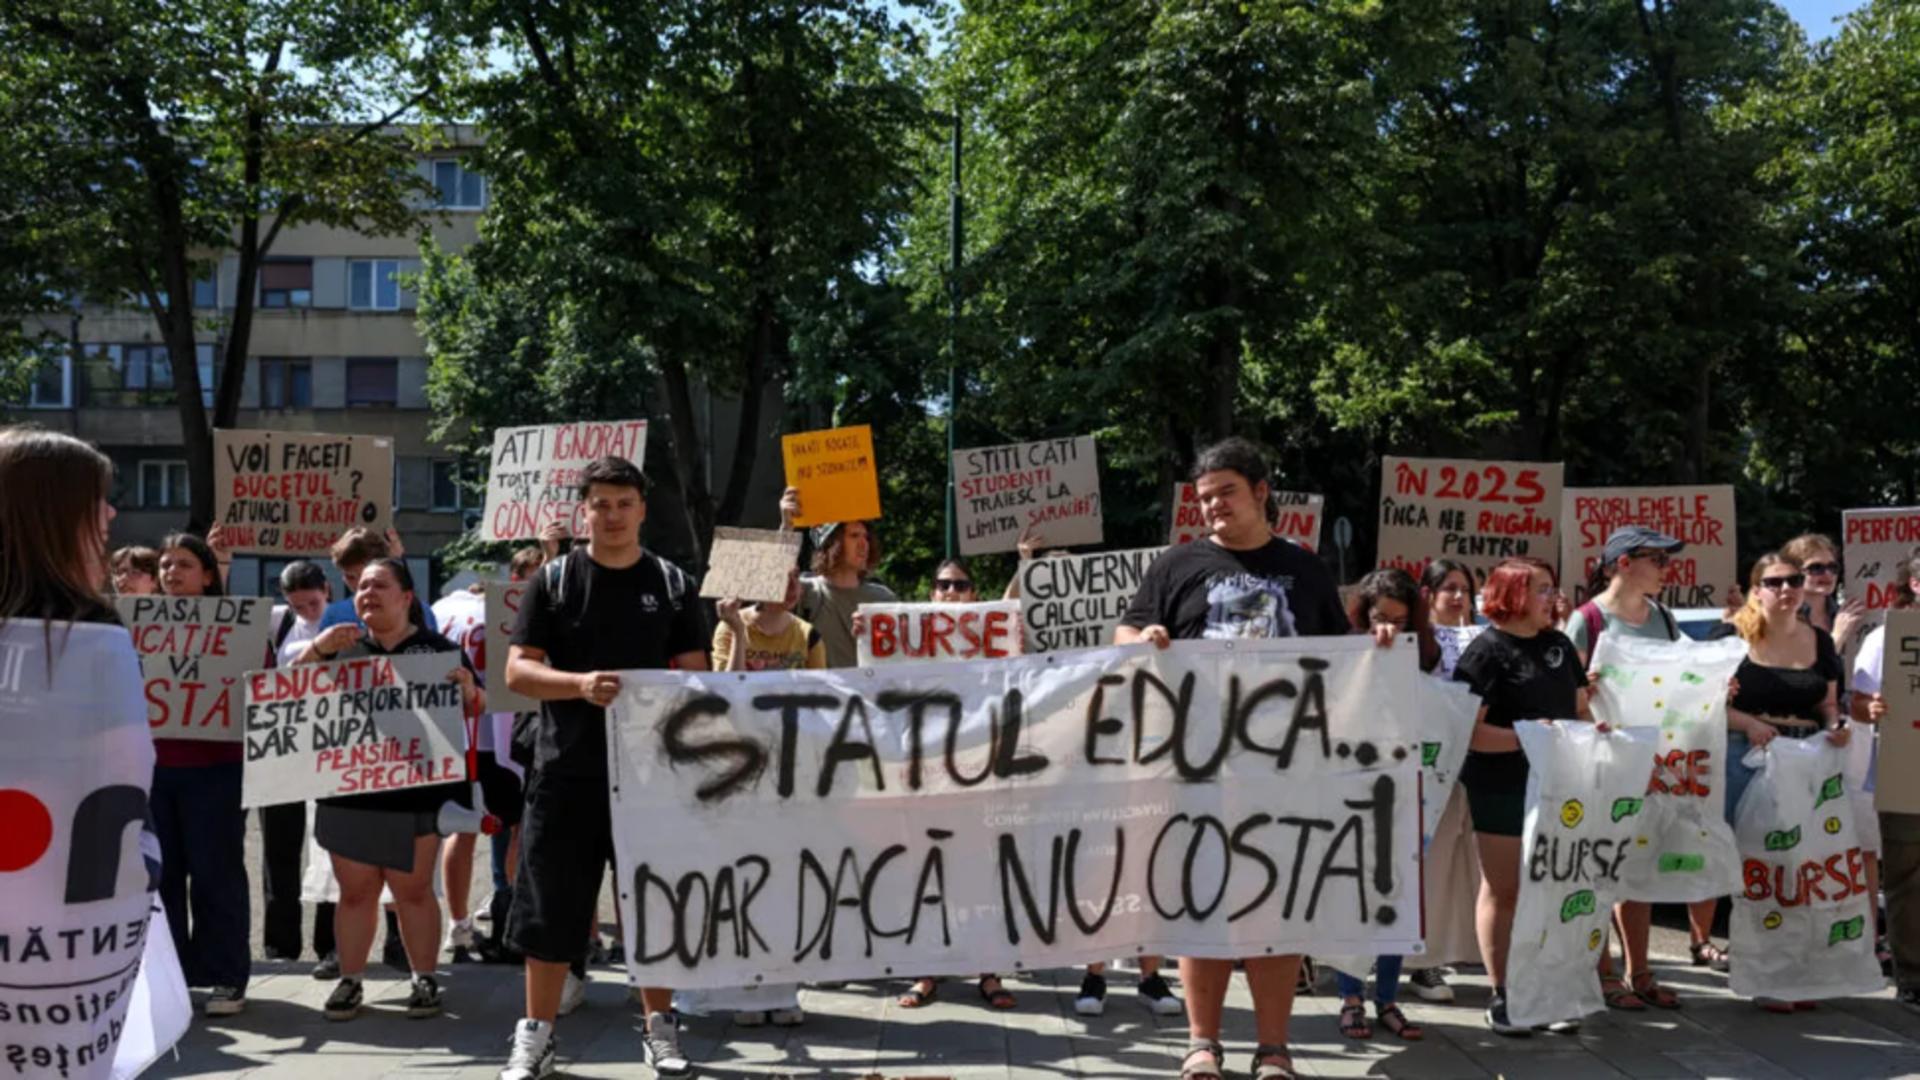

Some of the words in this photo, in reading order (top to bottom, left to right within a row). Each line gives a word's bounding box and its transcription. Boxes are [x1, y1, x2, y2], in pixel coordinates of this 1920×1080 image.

[552, 423, 646, 461] IGNORAT
[1046, 481, 1071, 500] LA
[1395, 461, 1428, 496] ÎN
[1434, 465, 1546, 505] 2025
[362, 502, 377, 523] O
[494, 501, 592, 539] CONSEC
[1438, 509, 1466, 532] NE
[1575, 493, 1712, 524] PROBLEMELE
[258, 528, 280, 546] CU
[1441, 532, 1529, 556] PENTRU
[214, 599, 256, 625] DE
[871, 611, 1008, 659] BURSE
[246, 699, 308, 732] ESTE
[315, 695, 330, 719] O
[339, 679, 460, 717] PRIORITATE
[246, 727, 299, 762] DAR
[316, 737, 424, 773] PENSIILE
[660, 685, 1050, 802] STATUL
[337, 757, 463, 793] SPECIALE
[1530, 834, 1631, 882] BURSE
[634, 854, 771, 969] DOAR
[999, 826, 1126, 945] NU
